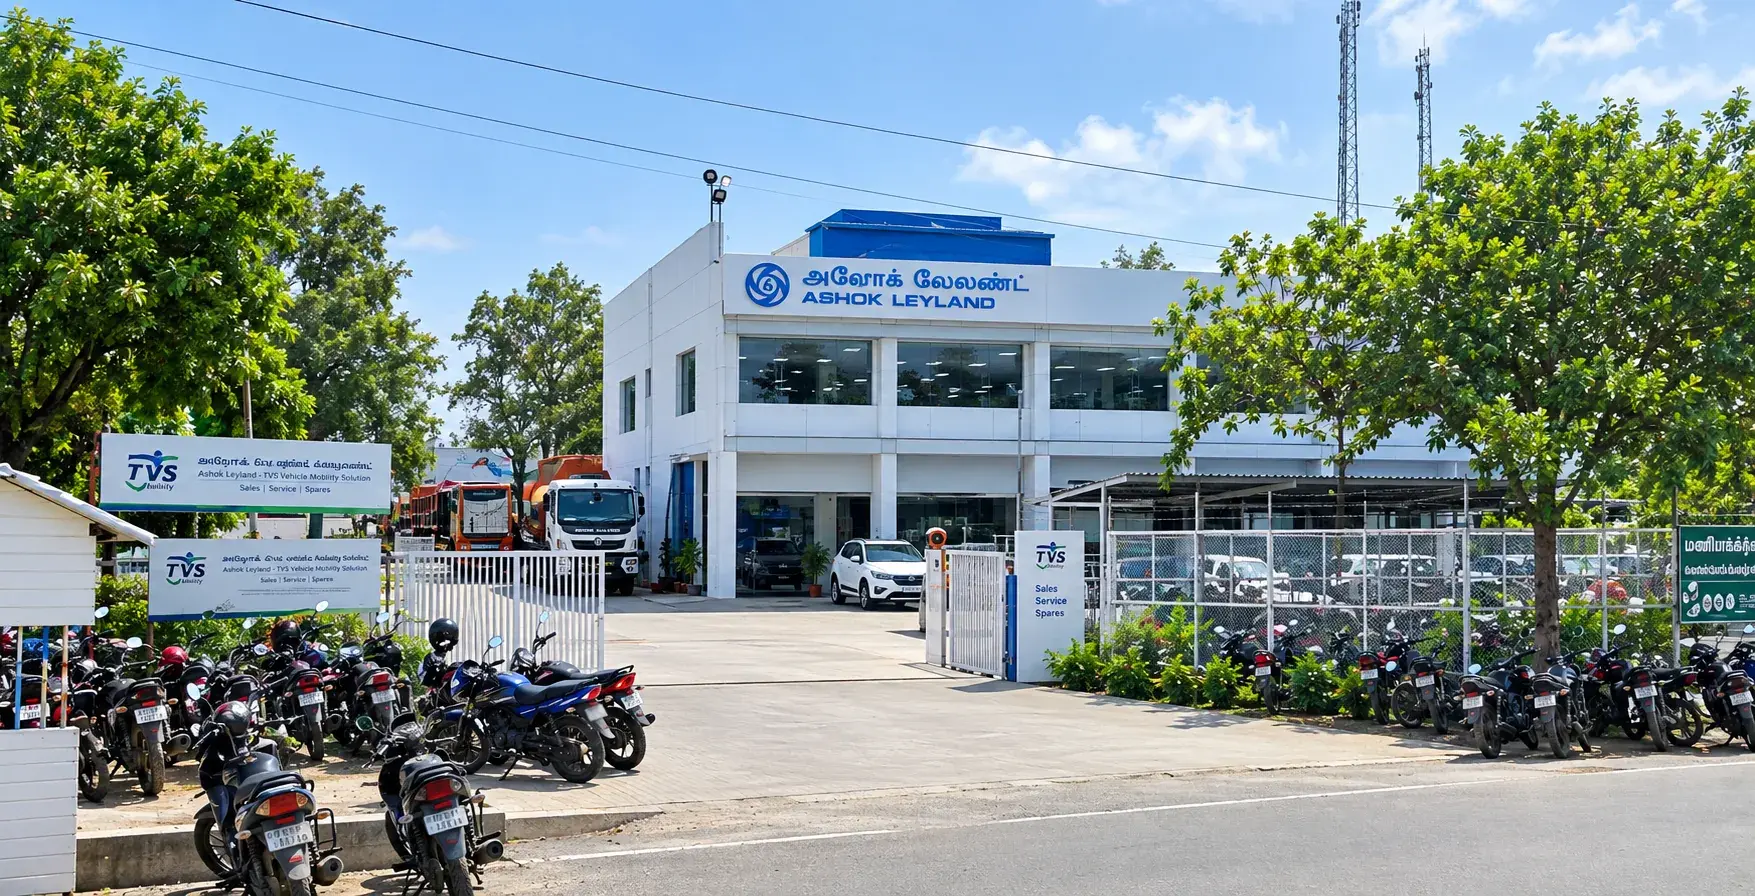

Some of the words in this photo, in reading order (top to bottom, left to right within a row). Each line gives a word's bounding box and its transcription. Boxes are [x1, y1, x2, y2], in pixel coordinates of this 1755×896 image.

[802, 291, 883, 306] ASHOK
[892, 293, 996, 310] LEYLAND
[128, 463, 178, 483] TVS
[197, 470, 224, 478] Ashok
[225, 470, 257, 480] Leyland
[239, 484, 261, 492] Sales
[268, 484, 297, 493] Service
[305, 485, 331, 494] Spares
[1036, 550, 1066, 563] TVS
[166, 563, 205, 578] TVS
[1035, 584, 1058, 593] Sales
[1035, 596, 1067, 605] Service
[1035, 609, 1064, 619] Spares
